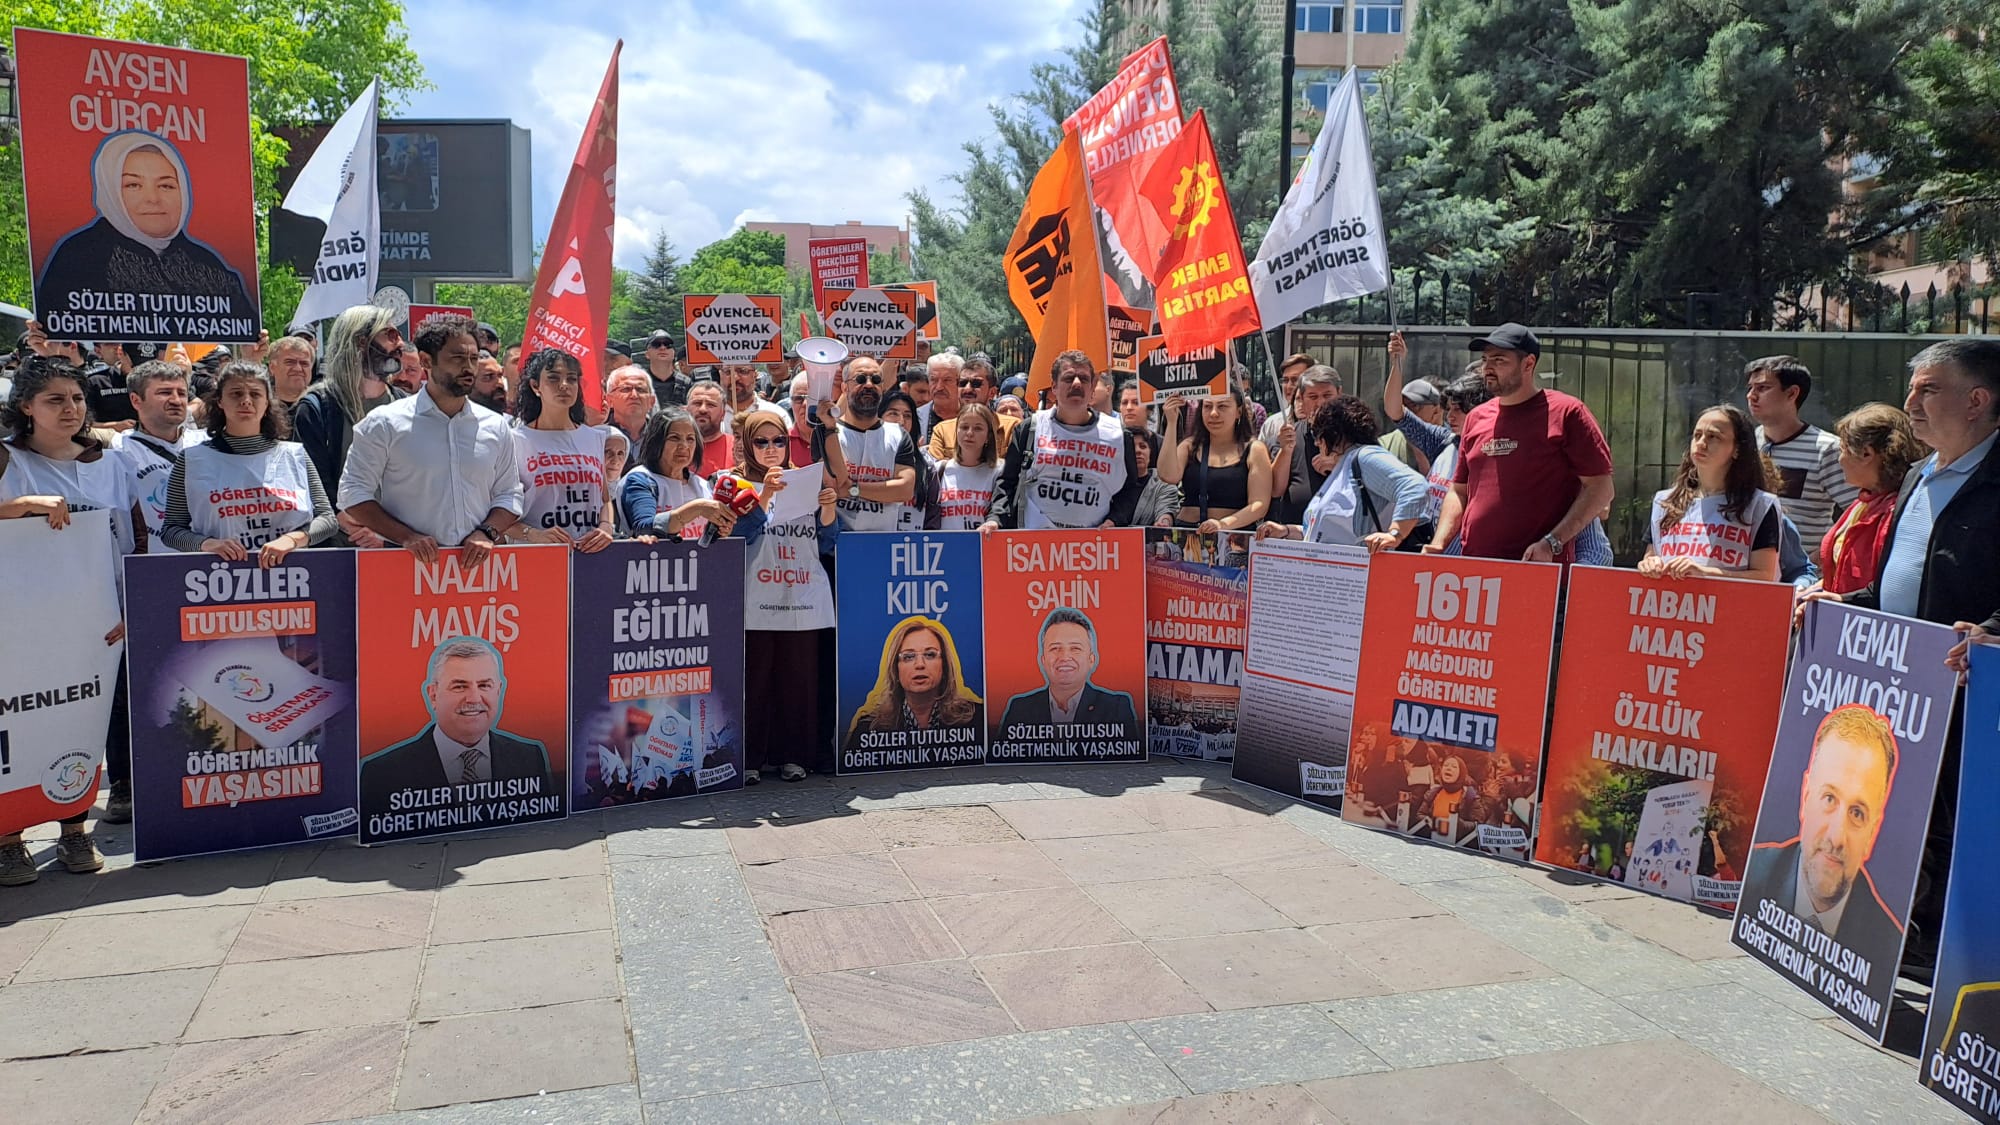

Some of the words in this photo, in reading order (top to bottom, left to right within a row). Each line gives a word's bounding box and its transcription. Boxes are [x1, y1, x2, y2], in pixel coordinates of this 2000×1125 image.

[85, 48, 188, 98] AYŞEN
[70, 89, 206, 142] GÜRCAN
[68, 289, 136, 311] SÖZLER
[139, 293, 231, 313] TUTULSUN
[47, 310, 172, 335] ÖĞRETMENLİK
[174, 316, 253, 340] YAŞASIN!
[534, 307, 586, 339] EMEKÇİ
[535, 322, 590, 357] HAREKET
[696, 323, 770, 337] ÇALIŞMAK
[834, 317, 905, 331] ÇALIŞMAK
[1164, 387, 1210, 399] HAKEVLERİ
[1037, 435, 1118, 459] ÖĞRETMEN
[1037, 452, 1112, 475] SENDİKASI
[566, 485, 590, 503] İLE
[1037, 481, 1101, 507] GÜÇLÜ!
[1061, 468, 1084, 485] İLE
[209, 486, 297, 504] ÖĞRETMEN
[218, 499, 298, 519] SENDİKASI
[246, 516, 271, 530] İLE
[778, 543, 796, 560] İLE
[890, 536, 945, 577] FİLİZ
[1007, 537, 1047, 574] İSA
[1049, 535, 1120, 571] MESİH
[185, 562, 310, 603] SÖZLER
[414, 552, 519, 596] NAZIM
[625, 550, 698, 594] MİLLİ
[757, 566, 810, 587] GÜÇLÜ!
[887, 580, 949, 621] KILIÇ
[1027, 574, 1100, 617] ŞAHİN
[1167, 596, 1239, 621] MÜLAKAT
[1414, 571, 1502, 626] 1611
[1628, 586, 1718, 625] TABAN
[186, 607, 312, 636] TUTULSUN!
[411, 597, 520, 652] MAVİŞ
[613, 597, 709, 643] EĞİTİM
[1412, 621, 1492, 652] MÜLAKAT
[613, 646, 709, 672] KOMİSYONU
[1628, 624, 1705, 668] MAAŞ
[1837, 612, 1911, 674] KEMAL
[1148, 643, 1243, 687] ATAMA
[1405, 649, 1494, 680] MAĞDURU
[1647, 664, 1680, 697] VE
[0, 674, 101, 716] MENLERİ
[611, 670, 711, 698] TOPLANSIN!
[1397, 671, 1497, 709] ÖĞRETMENE
[247, 685, 323, 724] ÖĞRETMEN
[265, 690, 334, 733] SENDİKASI
[1614, 691, 1704, 740] ÖZLÜK
[860, 730, 907, 749] SÖZLER
[909, 727, 976, 745] TUTULSUN
[1007, 722, 1054, 740] SÖZLER
[1056, 722, 1124, 739] TUTULSUN
[1391, 702, 1498, 748] ADALET!
[186, 742, 318, 776] ÖĞRETMENLİK
[844, 746, 930, 768] ÖĞRETMENLİK
[992, 739, 1079, 758] ÖĞRETMENLİK
[1081, 740, 1140, 759] YAŞASIN!
[1591, 731, 1719, 782] HAKLARI!
[186, 765, 320, 808] YAŞASIN!
[390, 786, 452, 811] SÖZLER
[456, 776, 541, 802] TUTULSUN
[369, 802, 484, 836] ÖĞRETMENLİK
[487, 795, 560, 822] YAŞASIN!
[1757, 898, 1803, 943] SÖZLER
[1802, 923, 1872, 987] TUTULSUN
[1738, 913, 1820, 987] ÖĞRETMENLİK
[1817, 966, 1881, 1028] YAŞASIN!
